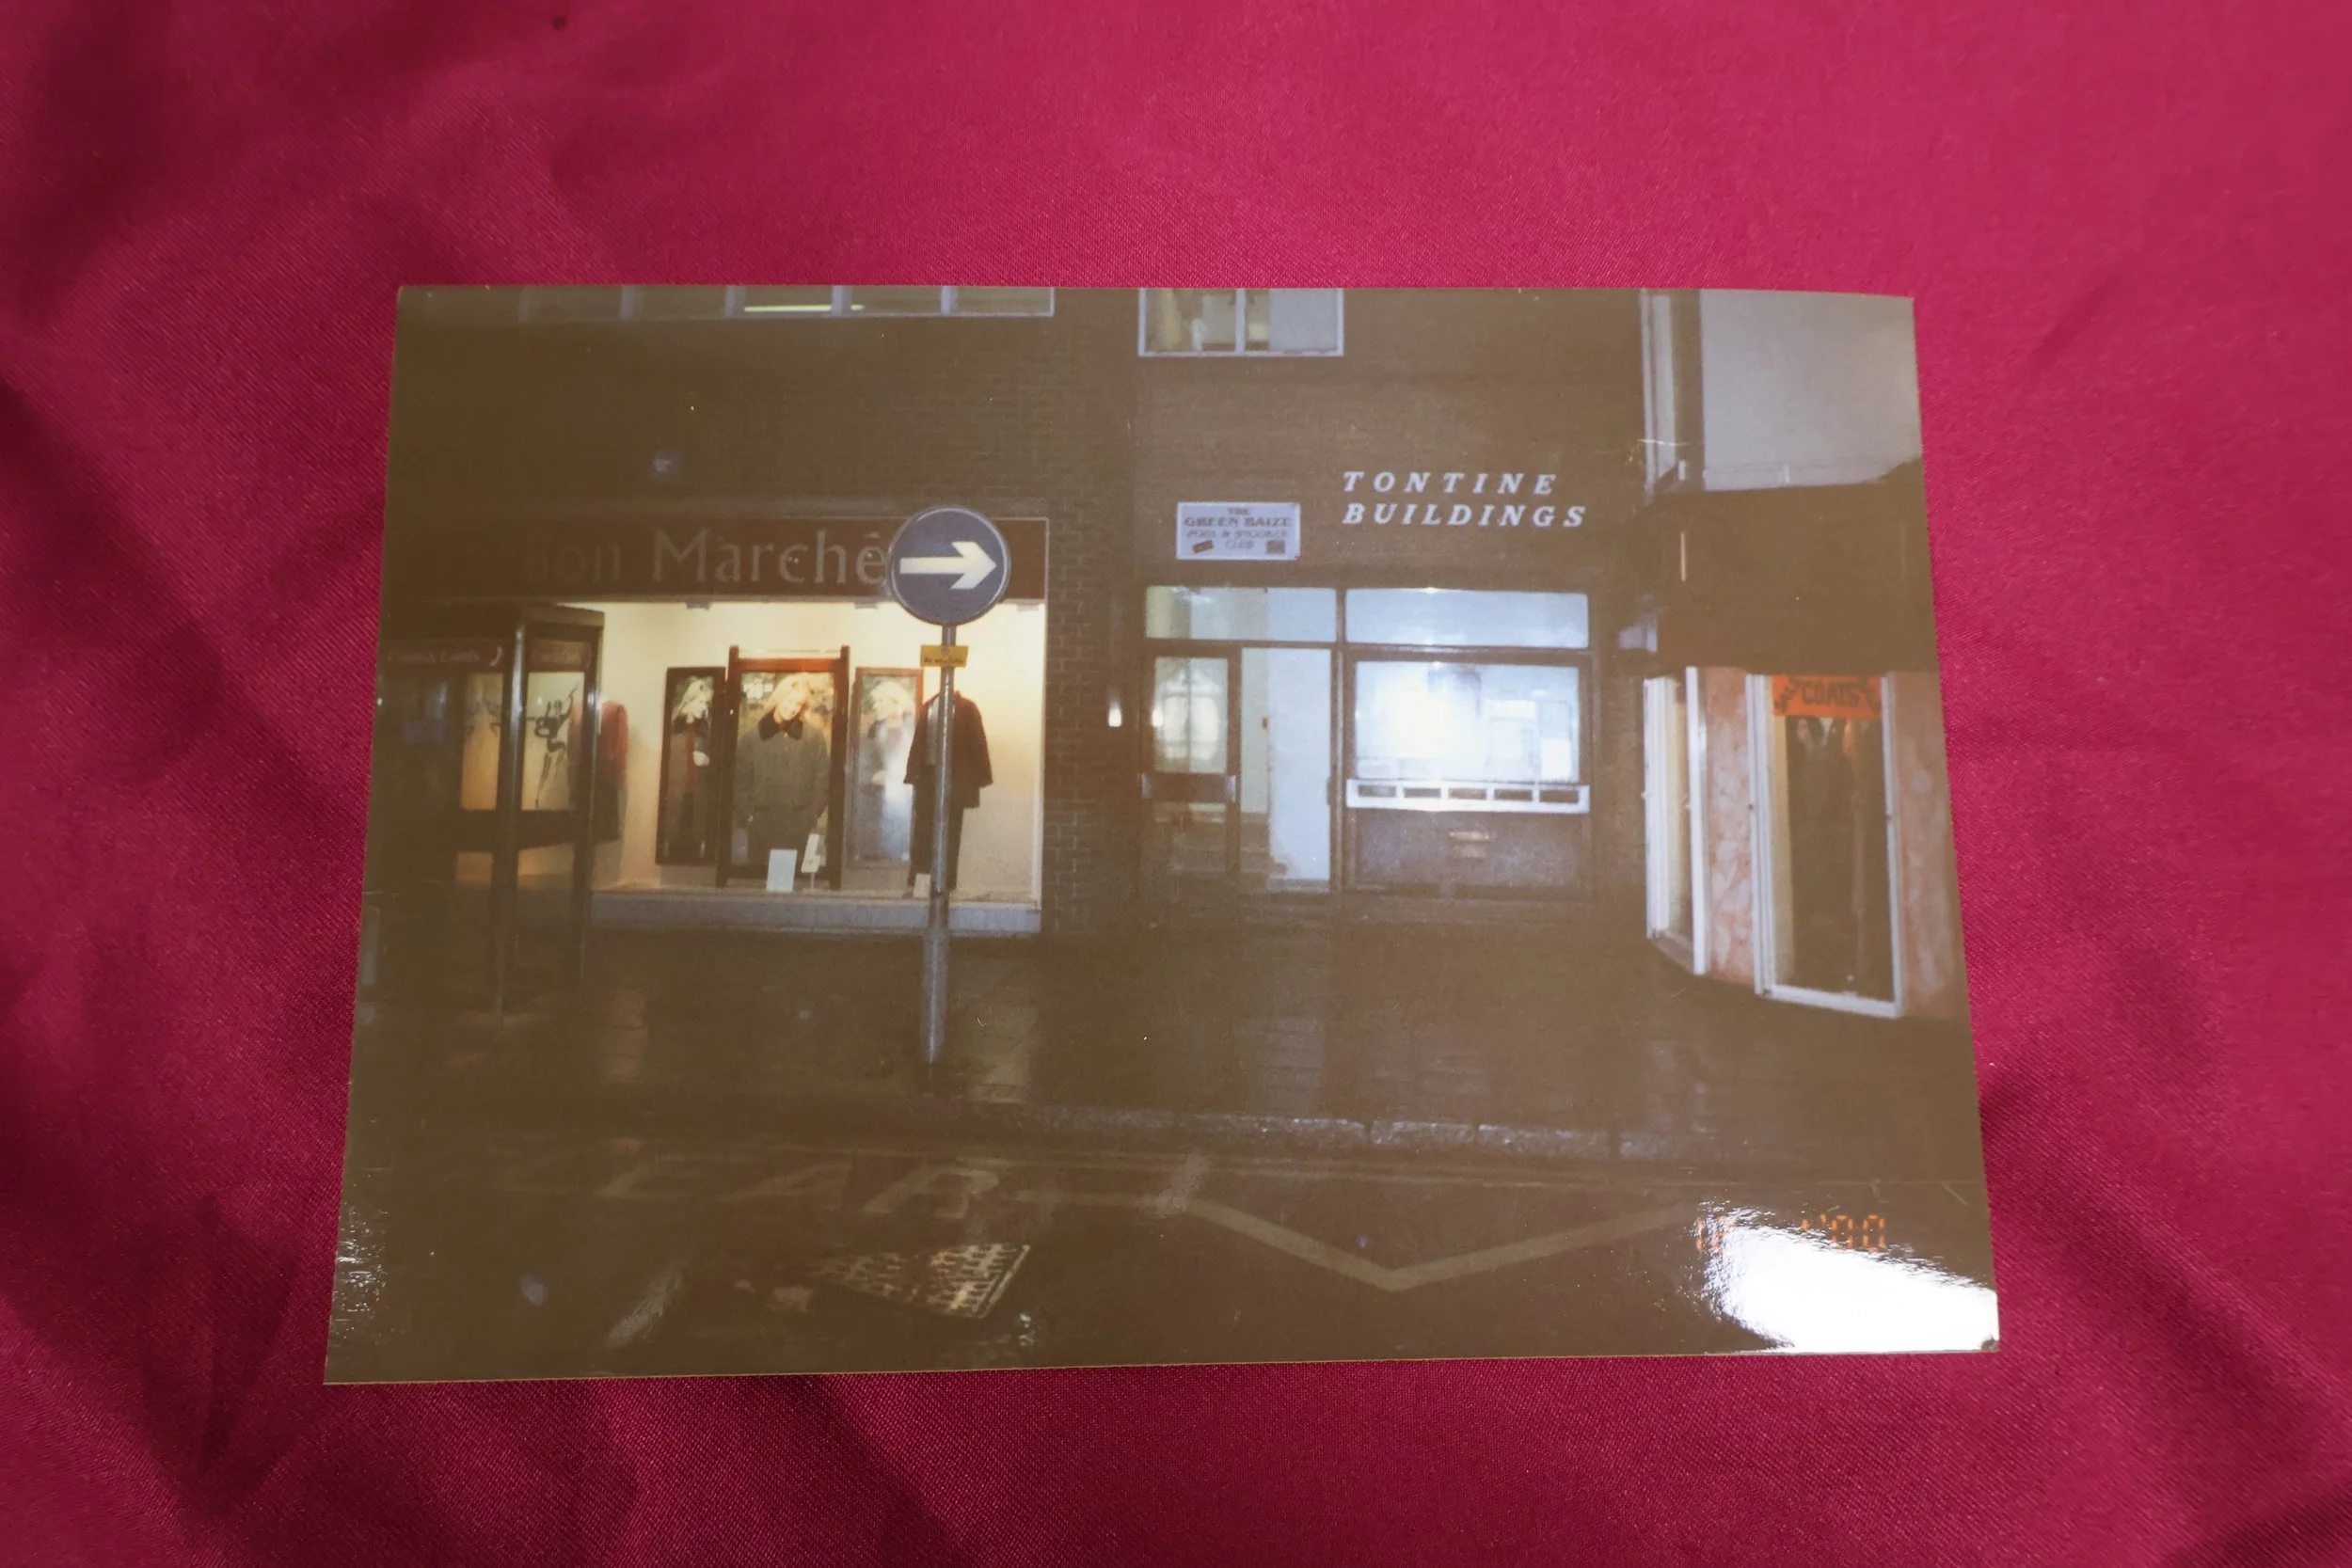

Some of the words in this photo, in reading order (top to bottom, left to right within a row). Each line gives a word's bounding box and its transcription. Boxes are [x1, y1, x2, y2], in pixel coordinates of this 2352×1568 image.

[1343, 471, 1556, 494] TONTINE
[1184, 517, 1239, 527] GREEN
[1245, 517, 1293, 527] BAIZE
[1343, 503, 1586, 527] BUILDINGS
